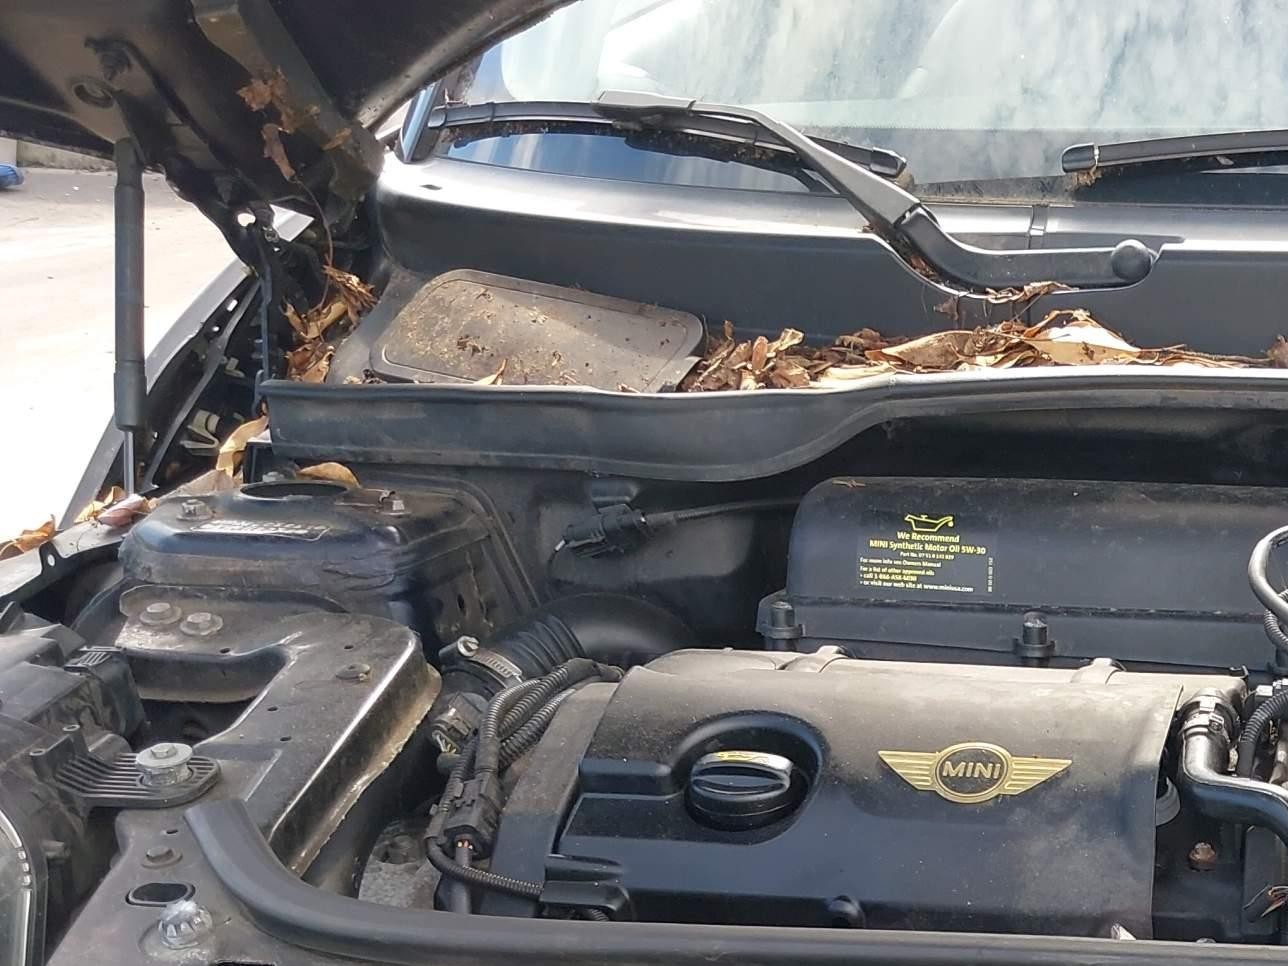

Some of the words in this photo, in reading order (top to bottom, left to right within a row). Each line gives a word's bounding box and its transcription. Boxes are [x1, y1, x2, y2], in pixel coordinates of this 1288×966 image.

[896, 531, 910, 540] We
[912, 532, 960, 542] Recommend
[869, 540, 888, 548] MINI
[889, 540, 924, 551] Synthetic
[925, 543, 948, 552] Motor
[949, 544, 960, 553] Oil
[961, 546, 986, 554] 5W-30
[942, 760, 1001, 780] MINI
